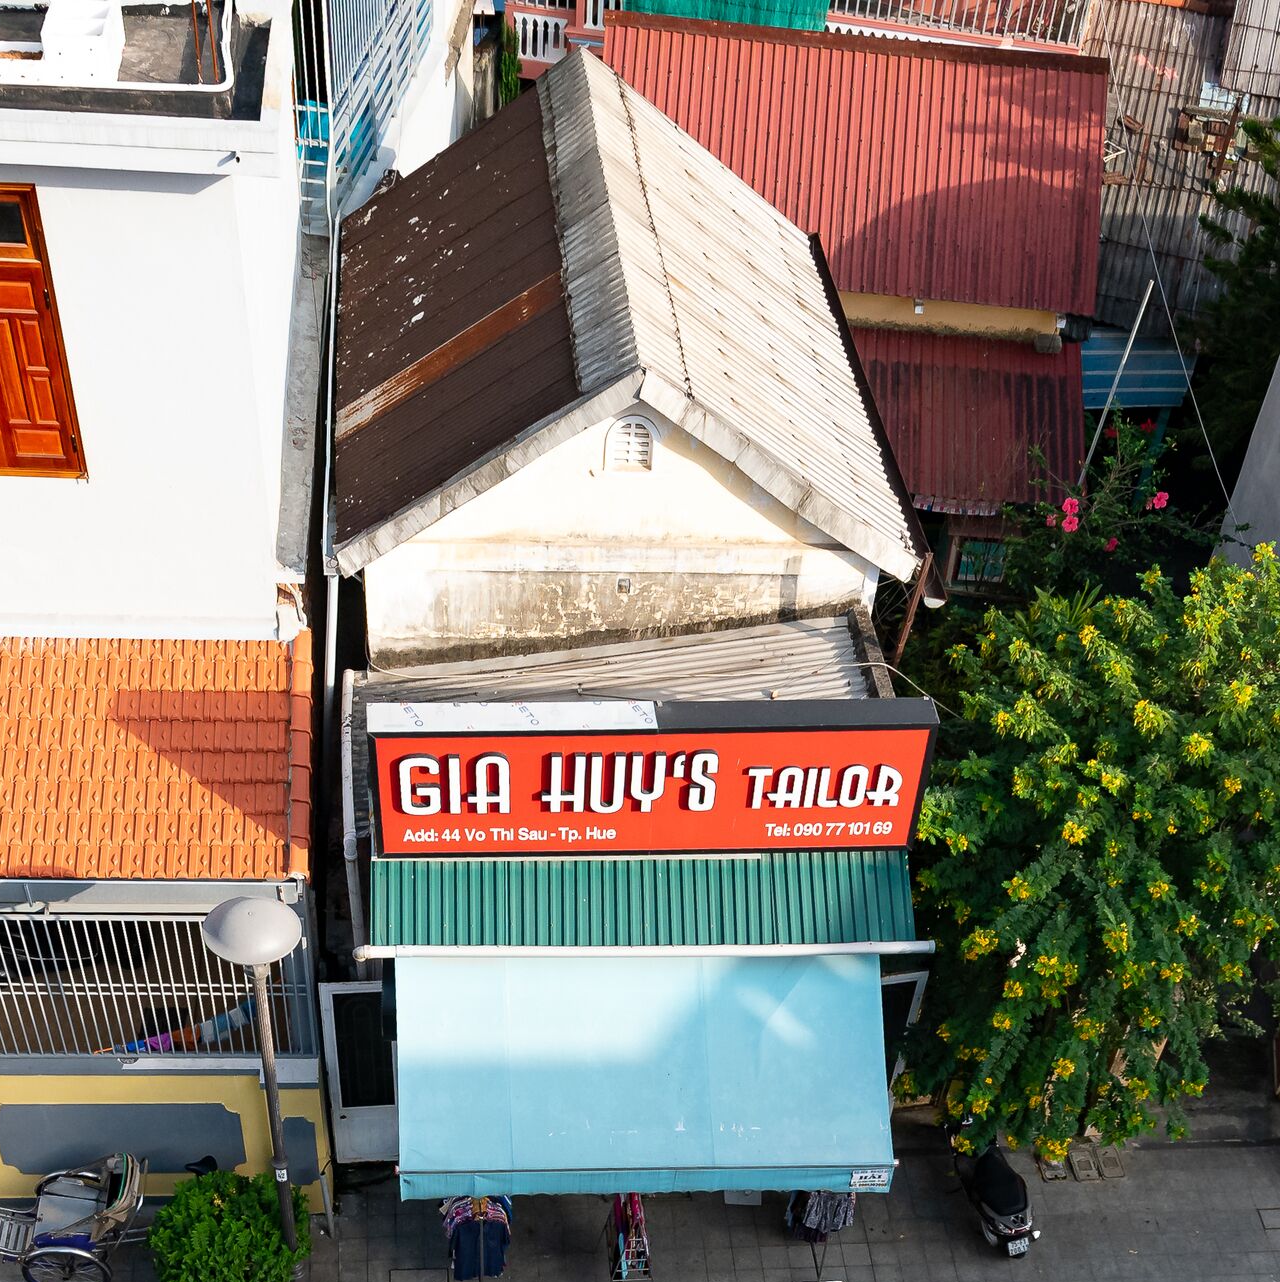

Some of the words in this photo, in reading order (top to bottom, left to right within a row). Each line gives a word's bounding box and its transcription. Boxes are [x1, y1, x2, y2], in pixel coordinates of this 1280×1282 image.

[398, 752, 512, 816] GIA
[540, 749, 720, 814] HUY'S
[745, 763, 904, 810] TAILOR
[402, 827, 439, 843] Add:
[441, 828, 461, 842] 44
[464, 828, 486, 842] Vo
[517, 827, 548, 842] Sau
[558, 827, 582, 844] Tp.
[584, 826, 618, 841] Hue
[764, 822, 791, 837] Tel:
[792, 822, 824, 837] 090
[824, 822, 846, 836] 77
